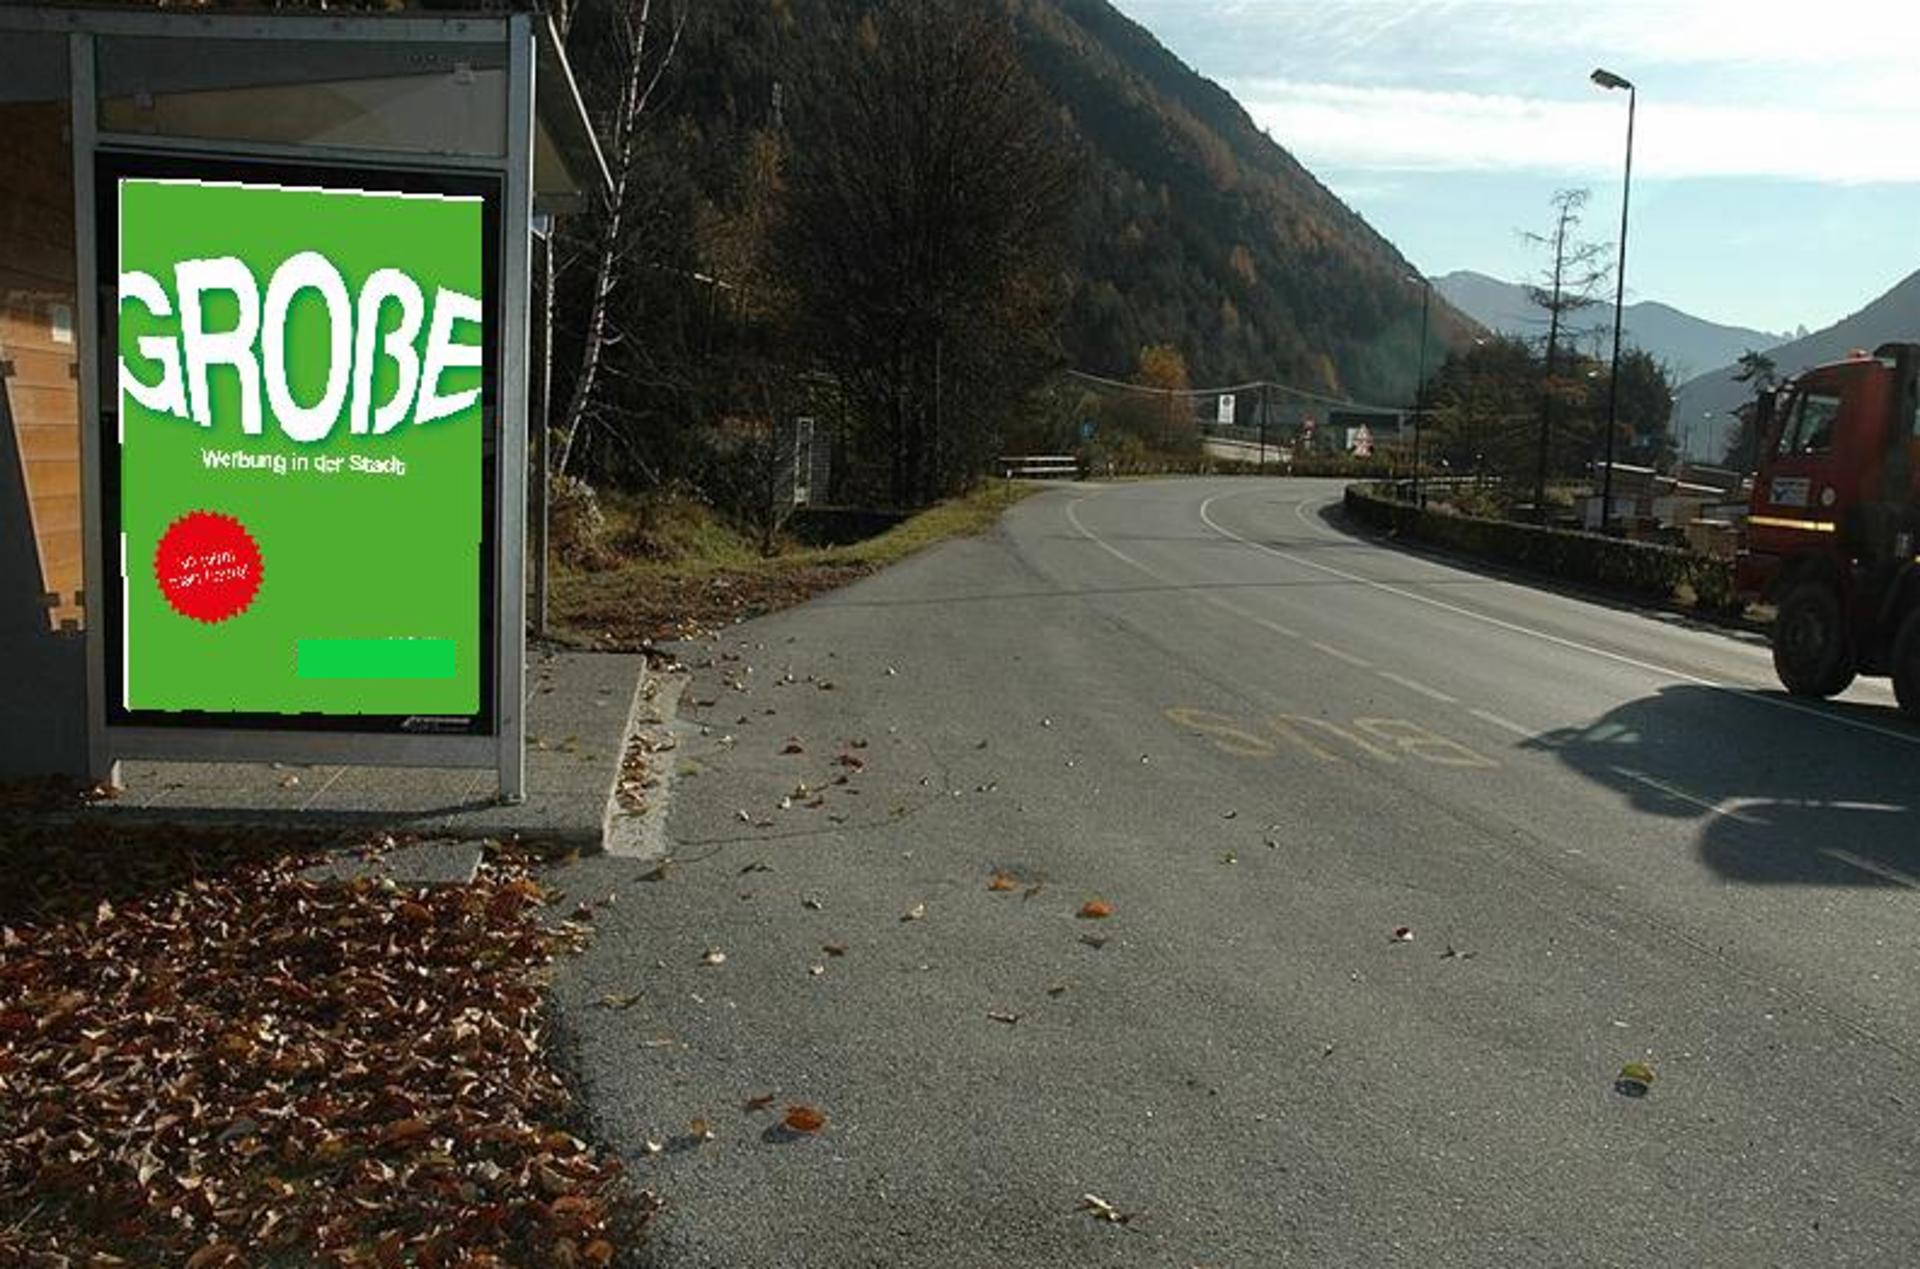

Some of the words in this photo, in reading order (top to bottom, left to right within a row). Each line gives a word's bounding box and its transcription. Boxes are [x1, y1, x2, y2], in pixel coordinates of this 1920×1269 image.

[202, 449, 288, 475] Werbung
[292, 453, 309, 471] in
[314, 455, 345, 473] der
[349, 455, 406, 476] Stadt
[1163, 708, 1502, 768] BUS
